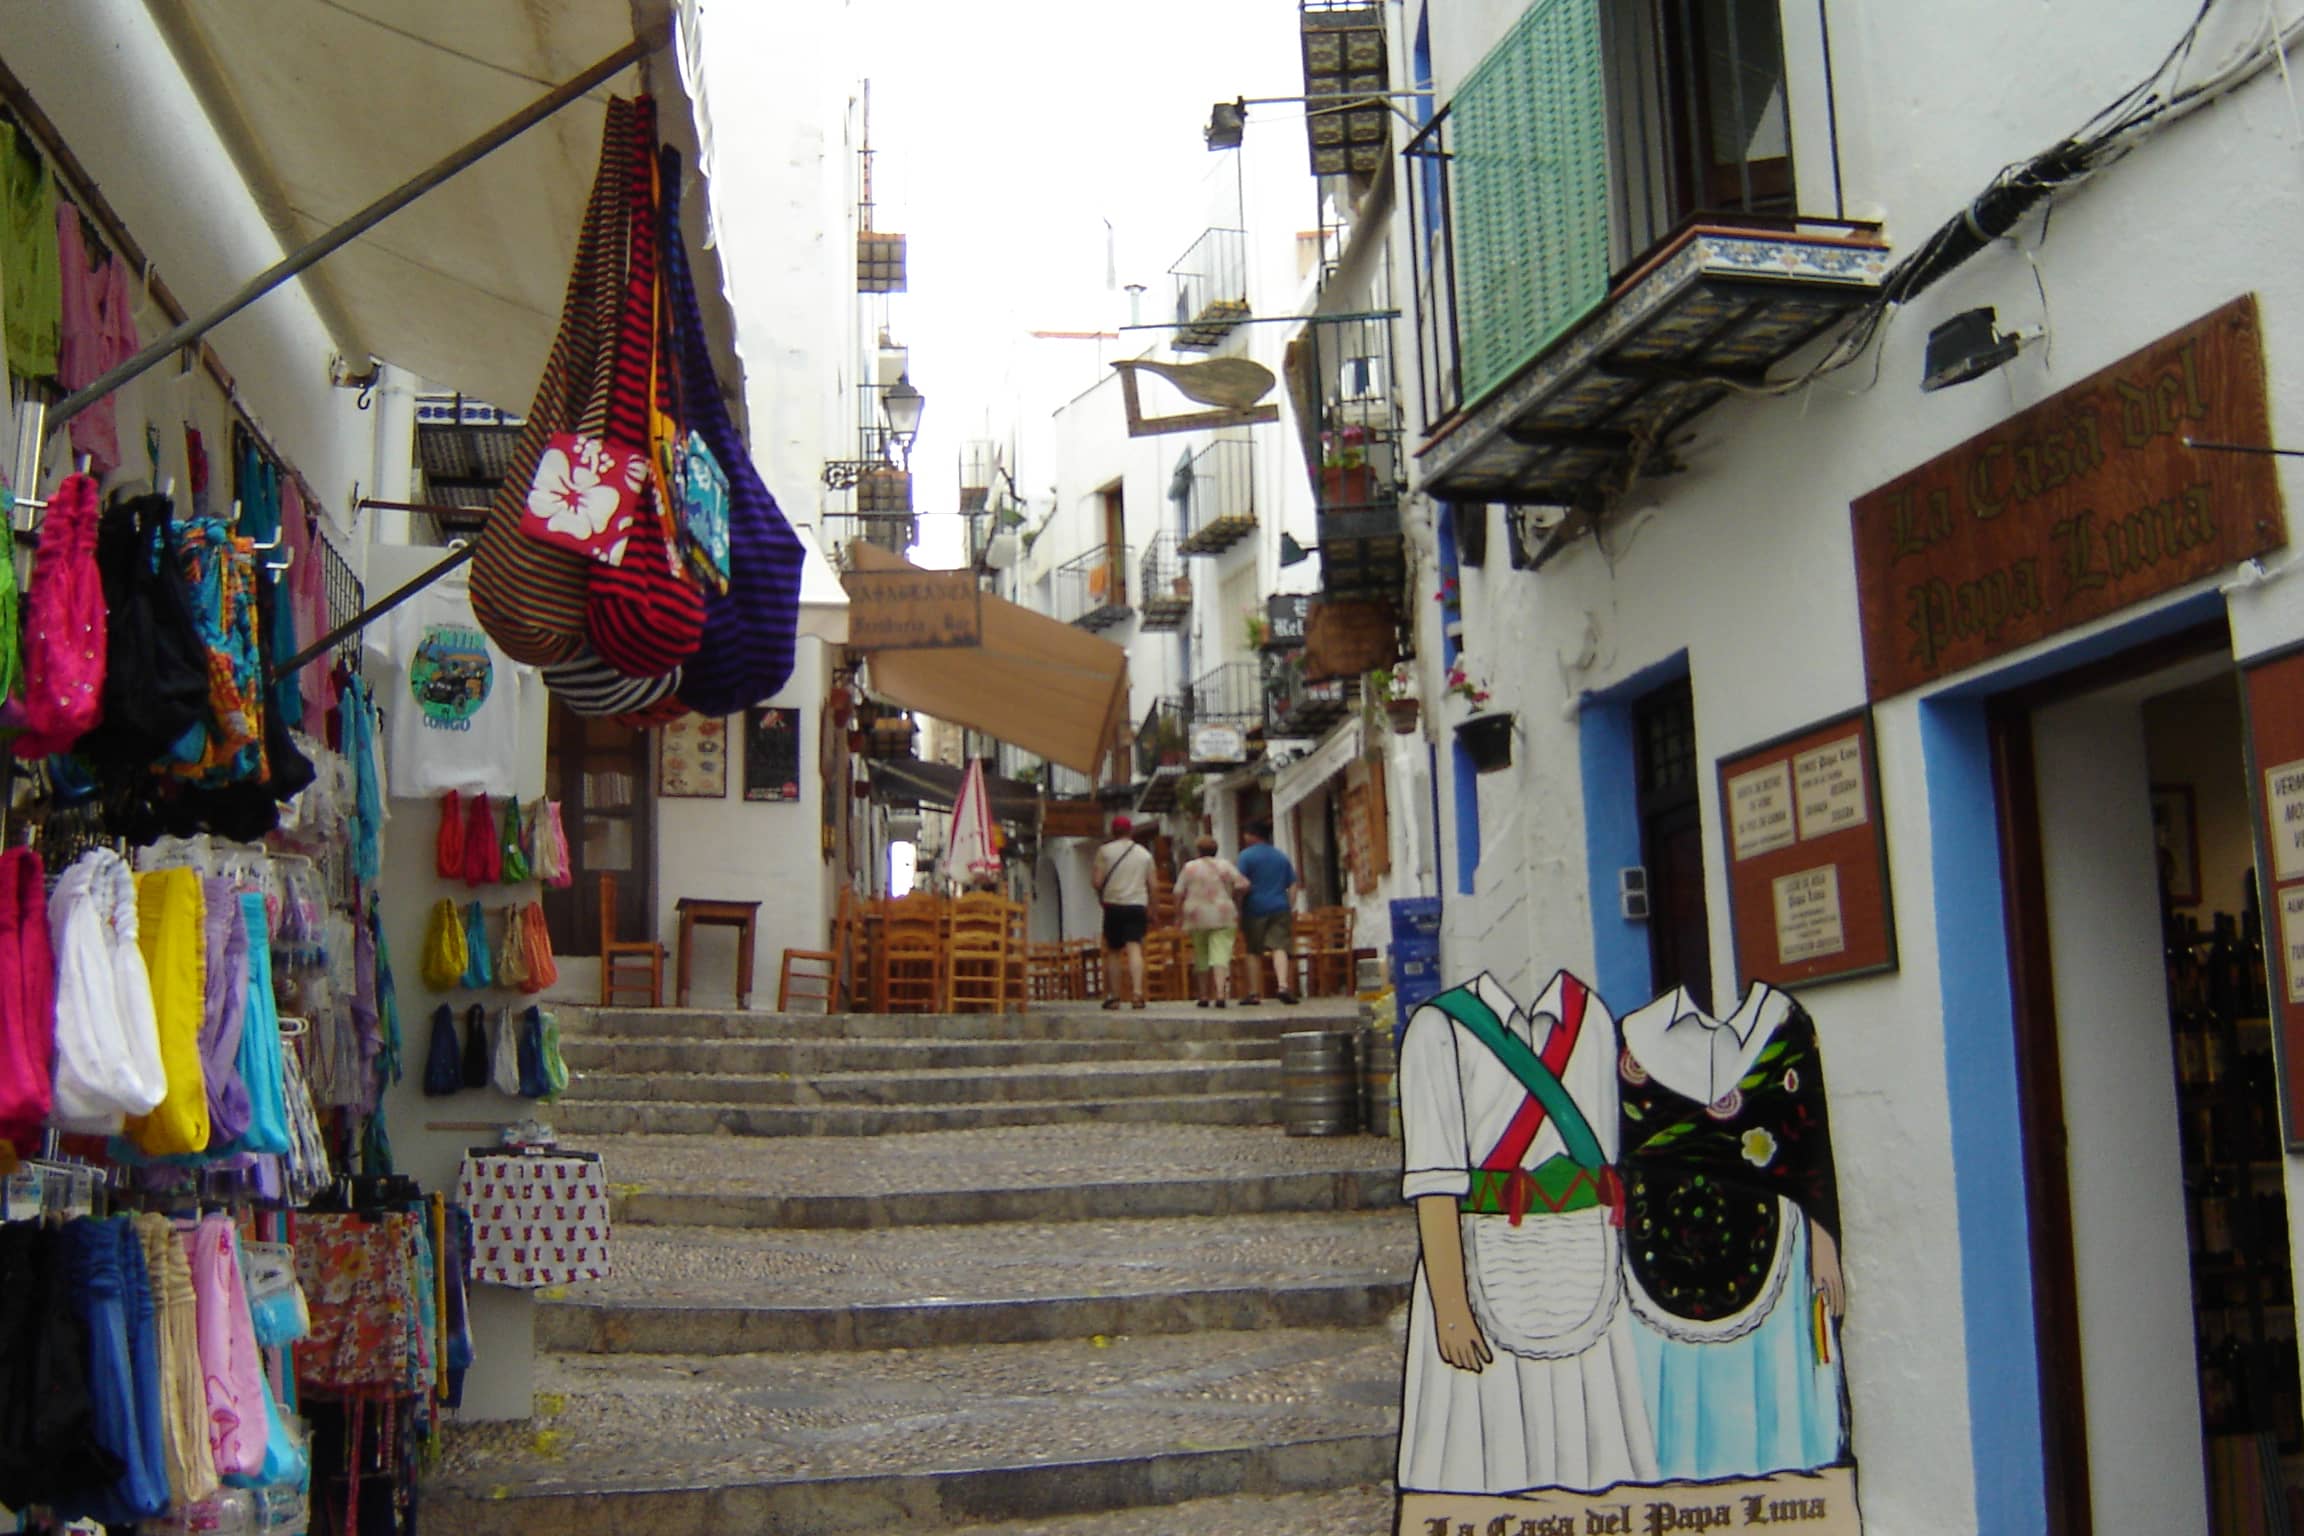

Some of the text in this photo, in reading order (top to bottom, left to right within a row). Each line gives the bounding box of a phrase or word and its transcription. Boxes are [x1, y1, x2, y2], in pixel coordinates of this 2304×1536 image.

[1892, 340, 2210, 561] La Casa del
[1906, 484, 2217, 671] Papa Luna
[1486, 1513, 1576, 1536] Casa
[1584, 1504, 1633, 1536] del
[1642, 1501, 1732, 1536] Papa
[1739, 1493, 1827, 1526] Luna
